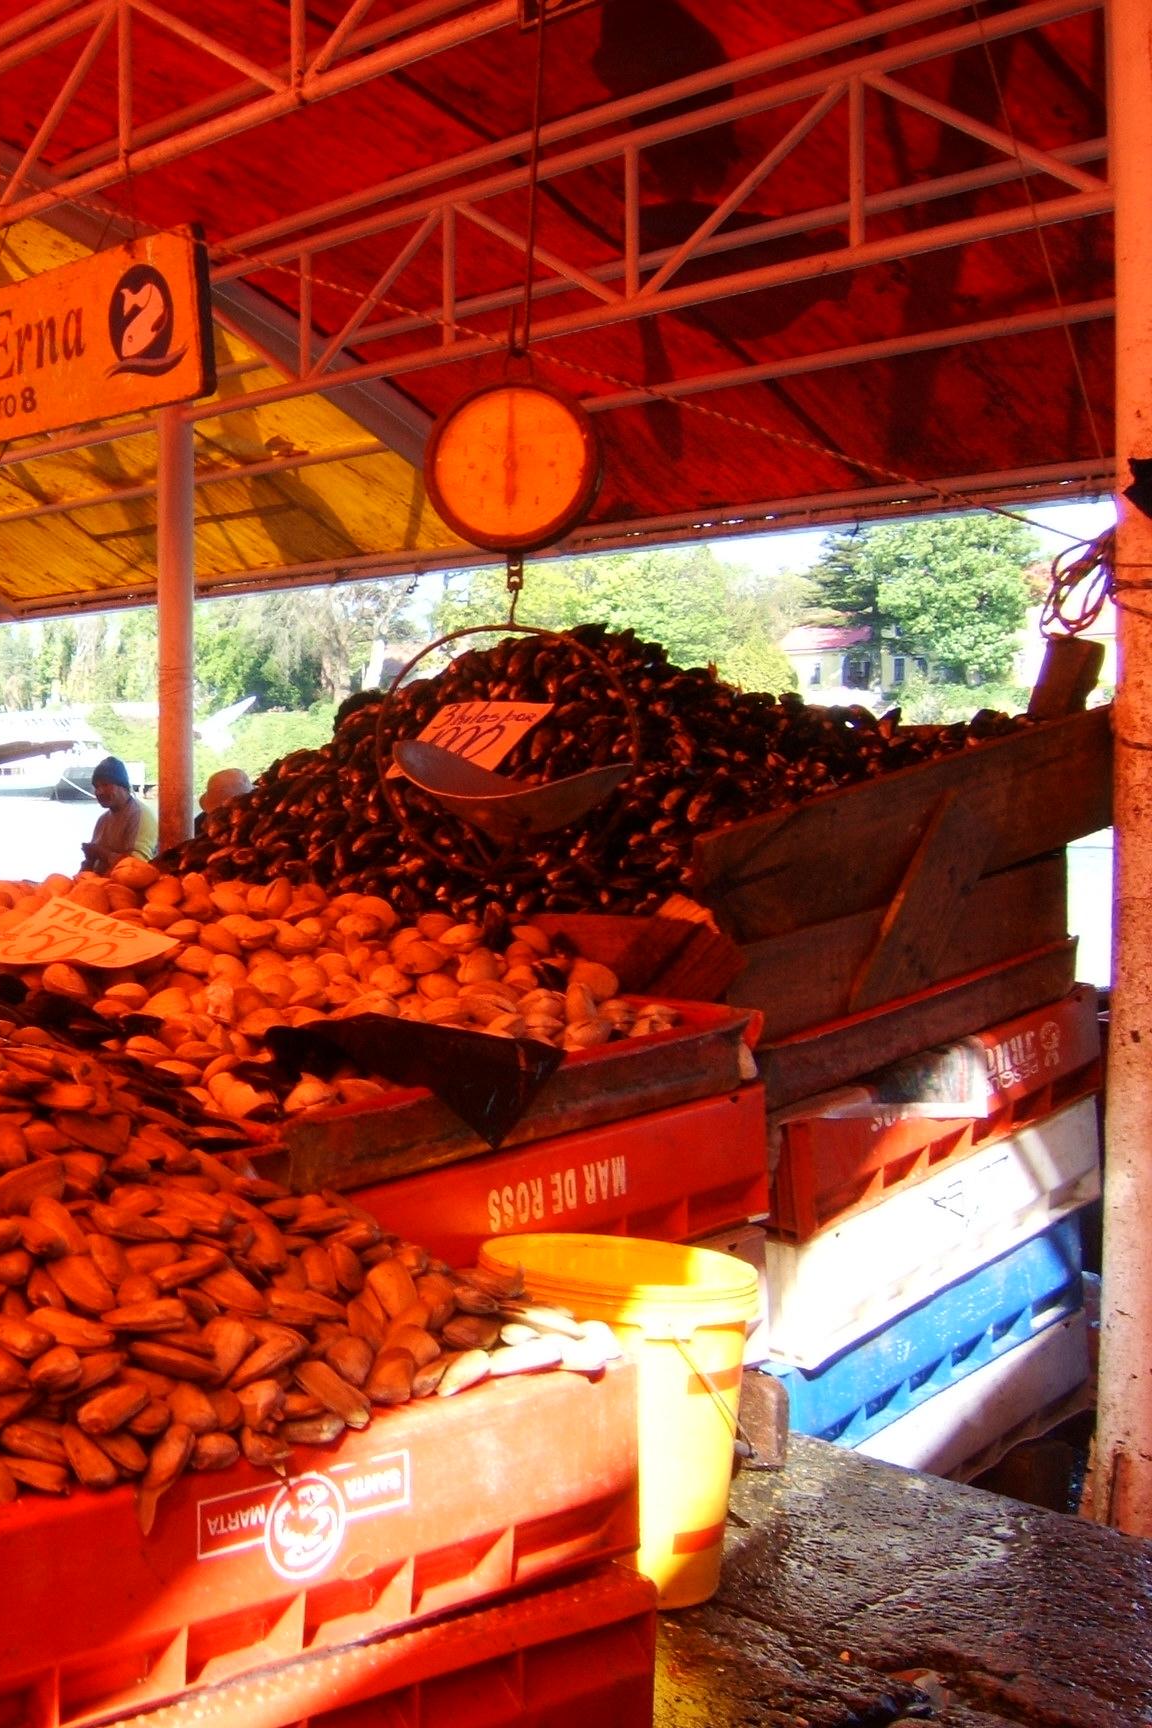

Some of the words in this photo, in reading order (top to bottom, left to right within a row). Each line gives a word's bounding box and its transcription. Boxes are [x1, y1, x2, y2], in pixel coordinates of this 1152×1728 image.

[21, 386, 38, 413] 8
[48, 903, 139, 939] TACAS
[550, 1168, 577, 1214] DE
[583, 1155, 626, 1204] MAR
[487, 1177, 544, 1233] ROSS
[343, 1467, 402, 1501] SANTA
[206, 1504, 266, 1536] MARTA
